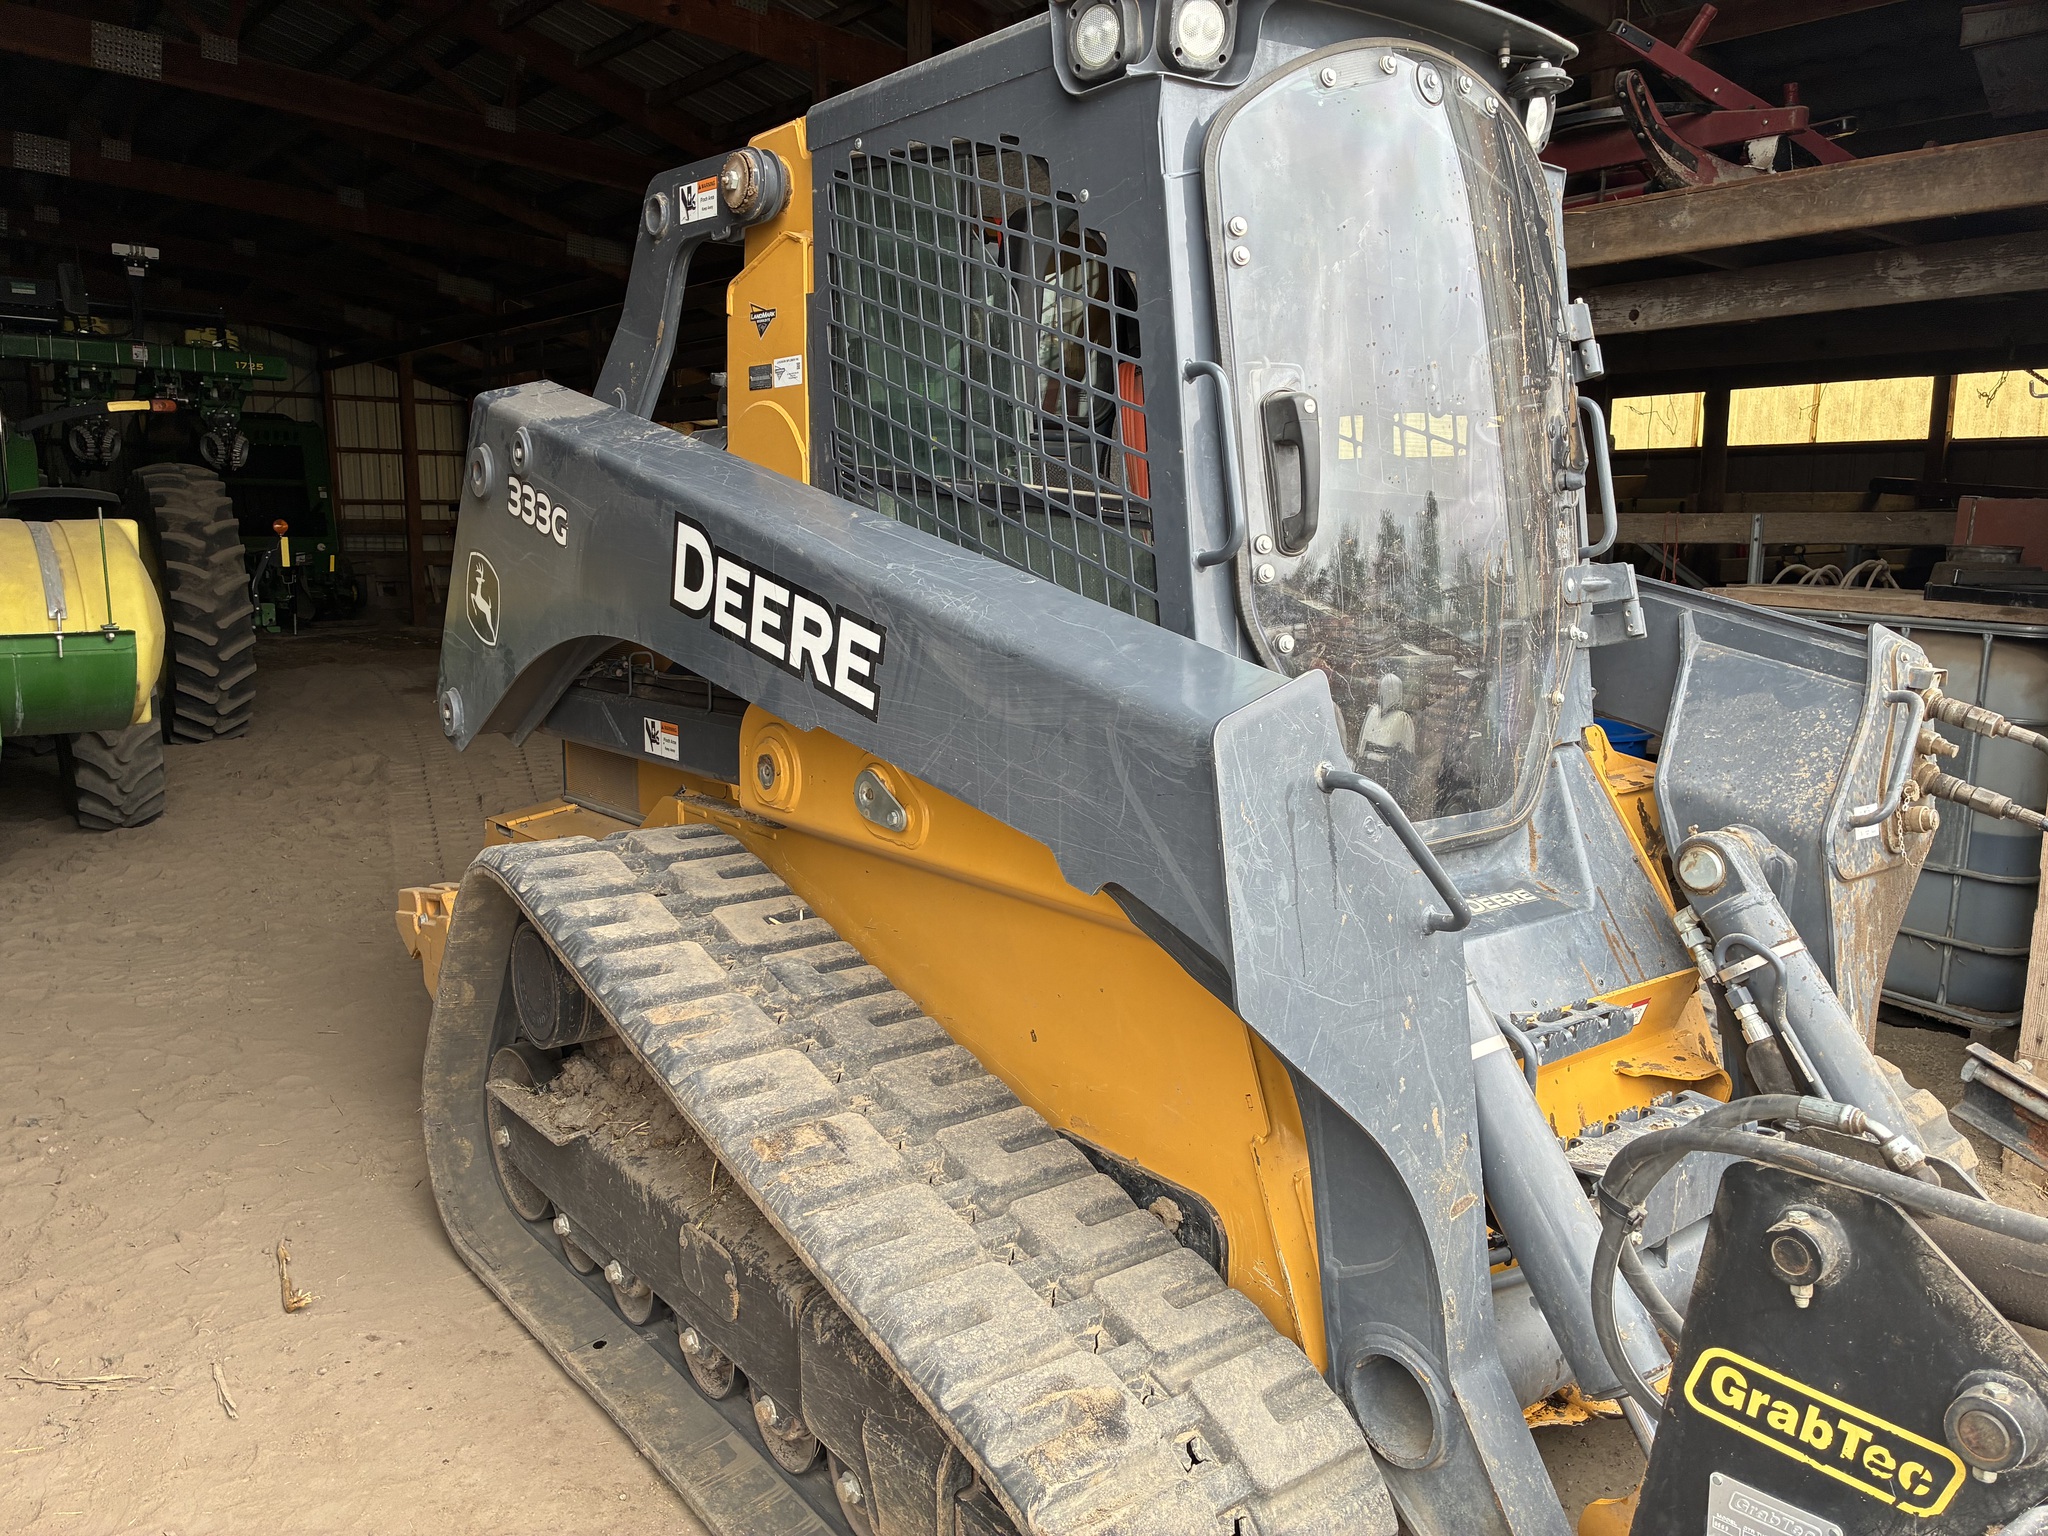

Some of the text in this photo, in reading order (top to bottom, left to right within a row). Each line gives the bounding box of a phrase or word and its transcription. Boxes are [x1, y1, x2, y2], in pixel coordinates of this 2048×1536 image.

[235, 361, 264, 370] 1725
[507, 476, 567, 546] 333G
[673, 521, 881, 711] DEERE
[1466, 889, 1538, 912] DEERE
[1710, 1366, 1932, 1496] GrabTec
